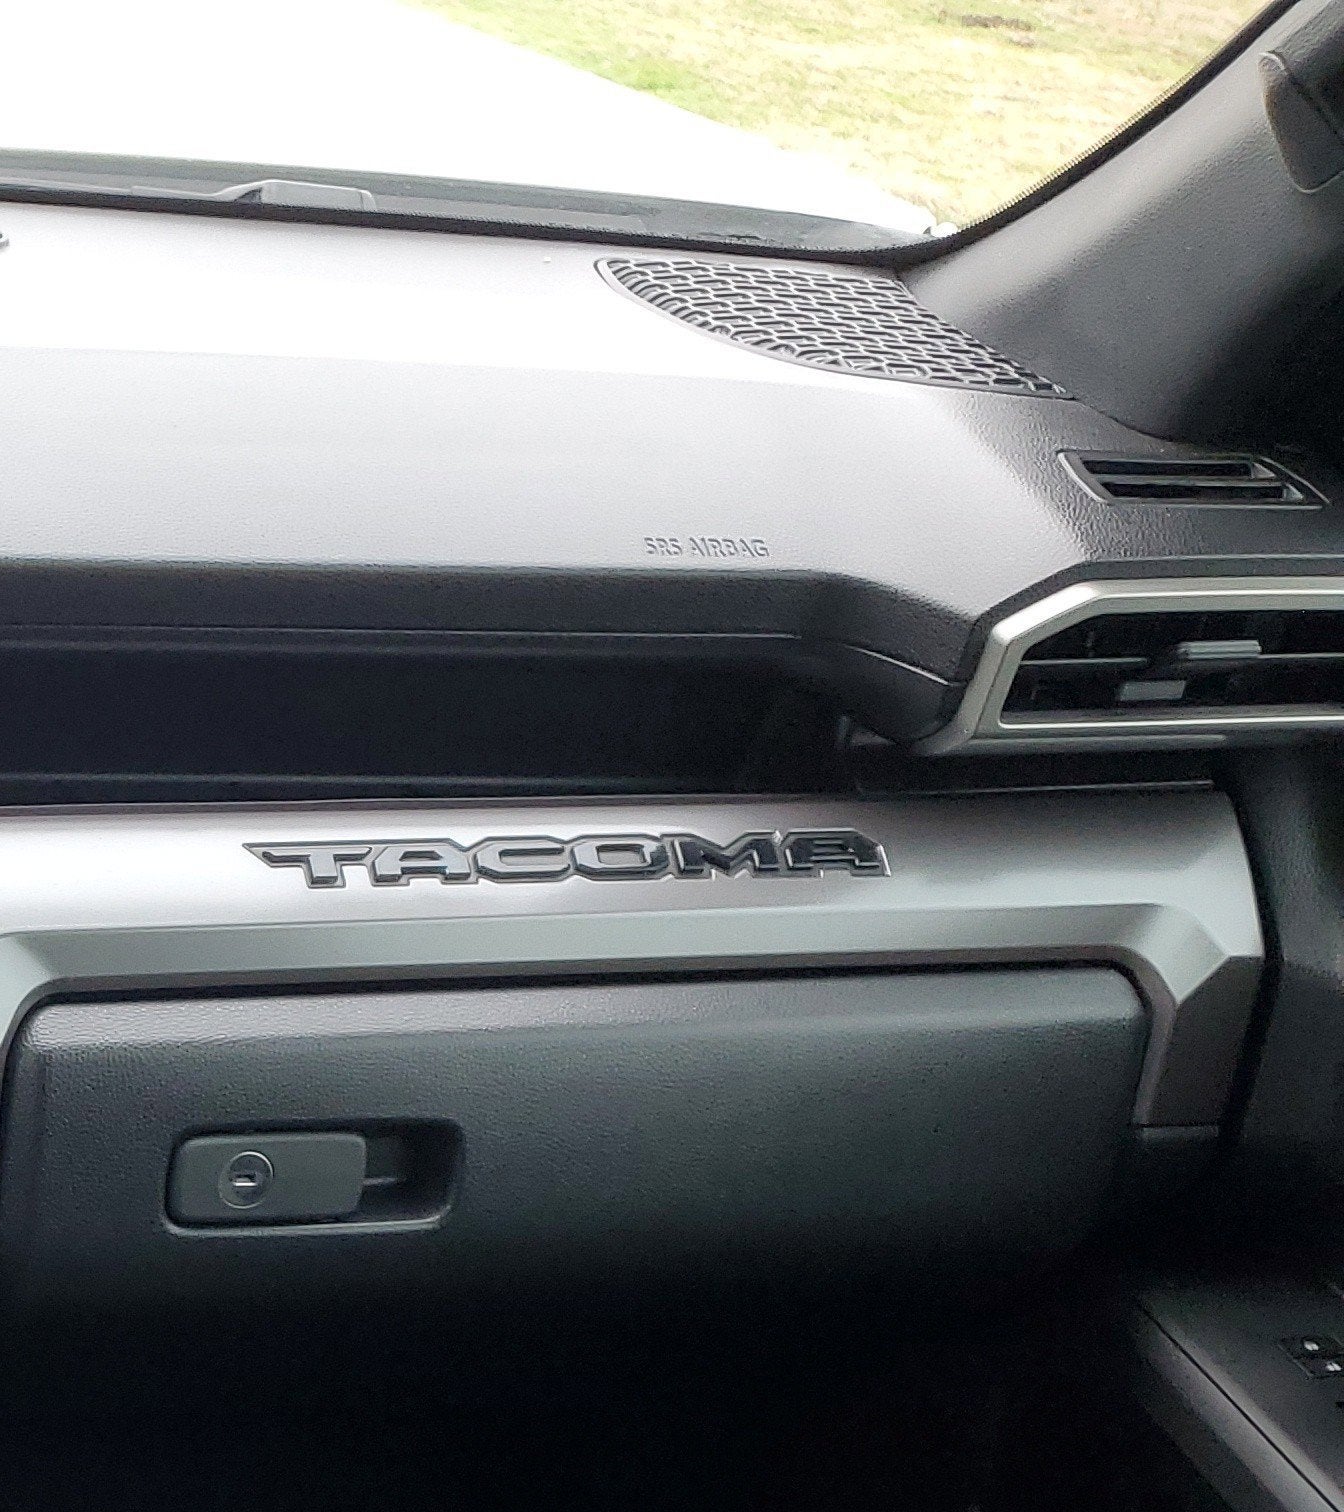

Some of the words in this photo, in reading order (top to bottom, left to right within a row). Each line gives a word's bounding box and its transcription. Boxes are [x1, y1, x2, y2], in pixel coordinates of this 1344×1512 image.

[644, 537, 682, 555] SRS
[689, 537, 770, 557] AIRBAG
[242, 828, 891, 888] TACOMA
